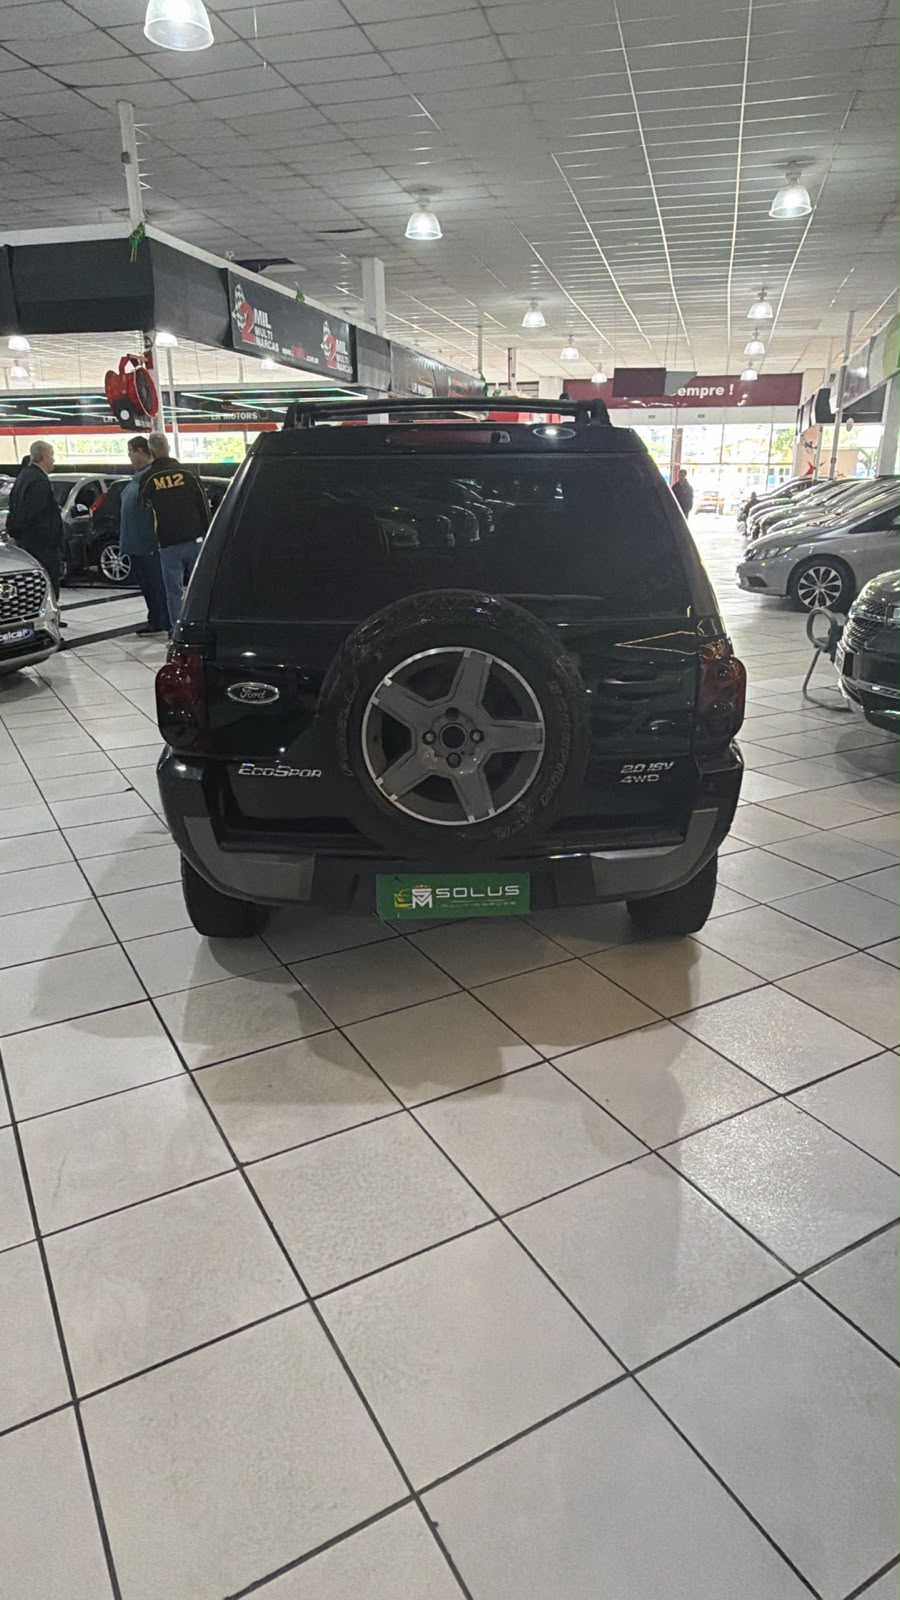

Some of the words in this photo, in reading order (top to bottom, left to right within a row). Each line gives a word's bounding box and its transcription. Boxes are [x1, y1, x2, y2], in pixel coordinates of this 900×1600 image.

[253, 308, 272, 330] MIL
[254, 325, 273, 341] MULTI
[255, 337, 280, 352] MARCAS
[668, 386, 725, 399] empre
[223, 411, 258, 420] MOTORS
[153, 473, 185, 490] M12
[240, 687, 267, 699] Ford
[620, 774, 660, 783] 4WD
[436, 885, 520, 898] SOLUS
